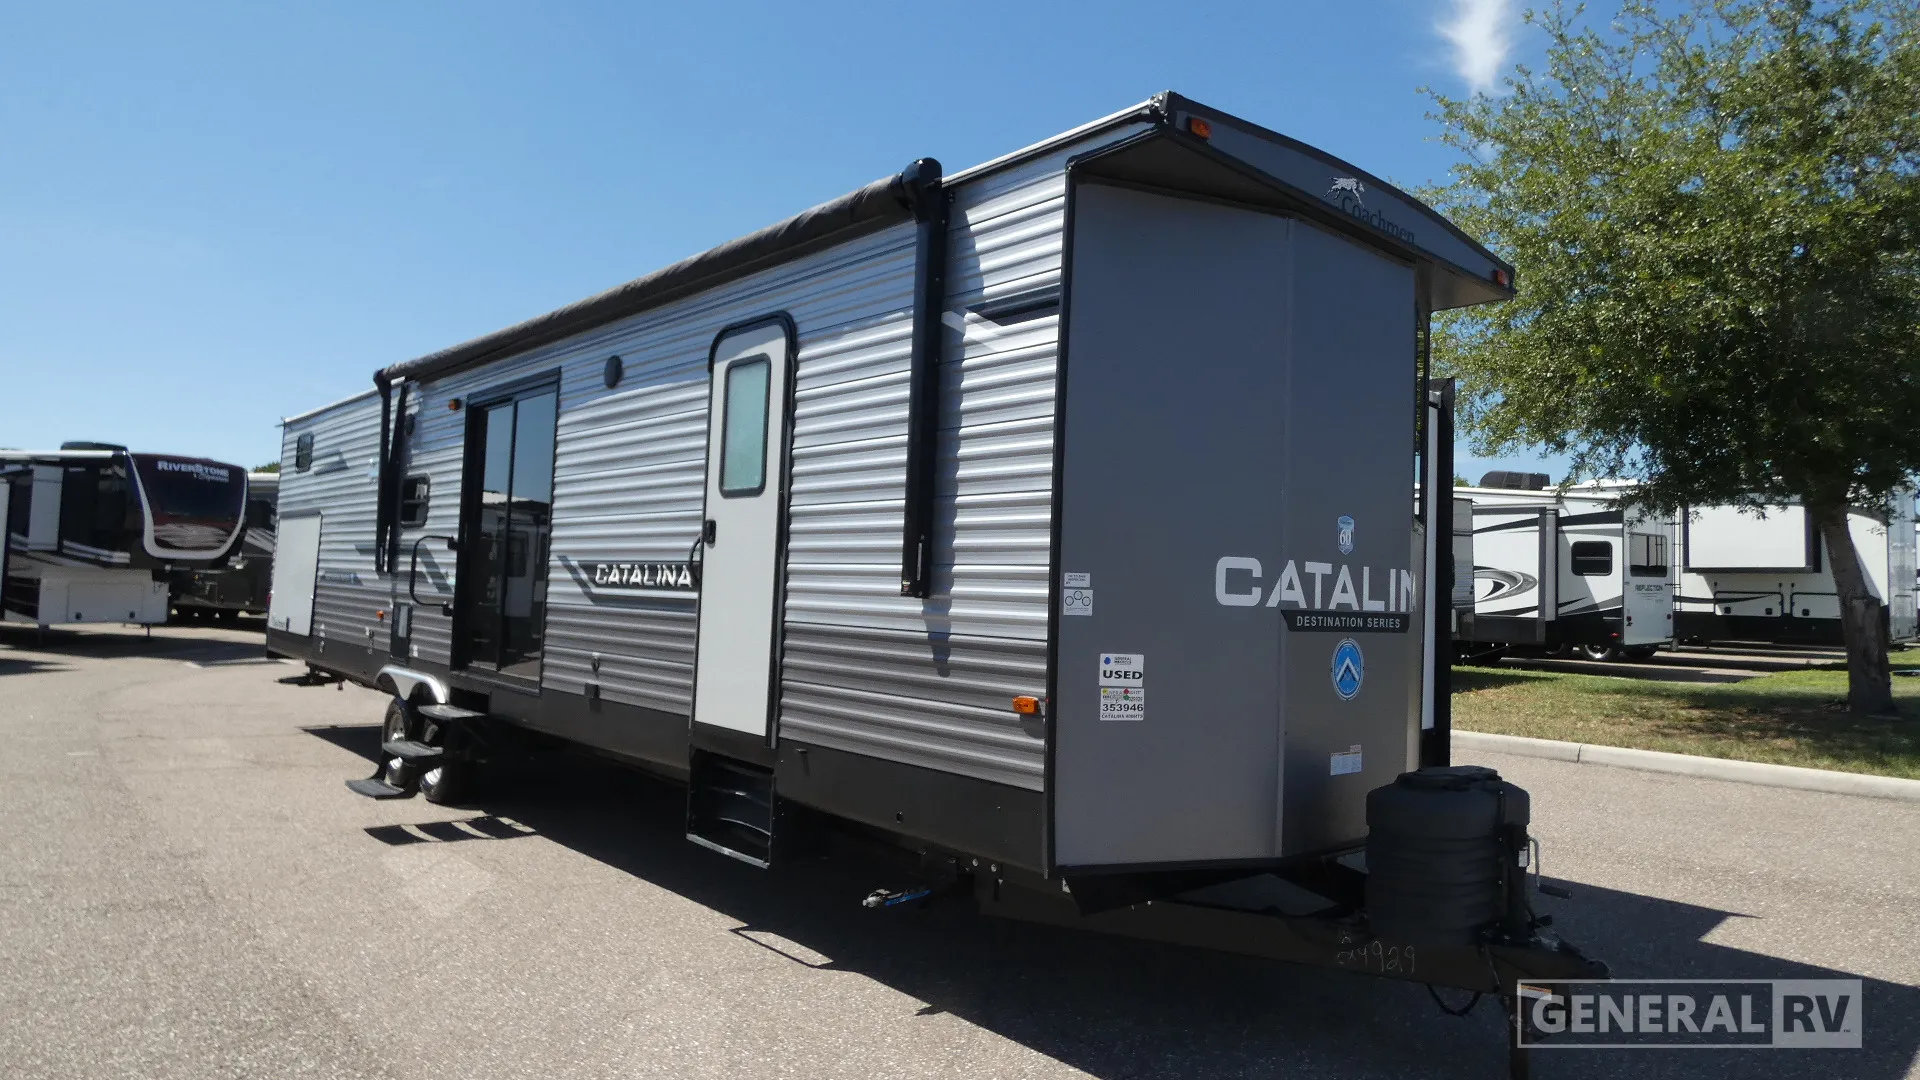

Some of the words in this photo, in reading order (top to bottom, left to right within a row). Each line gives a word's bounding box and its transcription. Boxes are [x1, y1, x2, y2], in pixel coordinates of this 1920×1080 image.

[1340, 195, 1415, 245] Coachmen
[595, 563, 692, 588] CATALINA
[1296, 615, 1364, 629] DESTINATION
[1366, 617, 1401, 629] SERIES
[1102, 669, 1143, 680] USED
[1102, 703, 1144, 712] 353946
